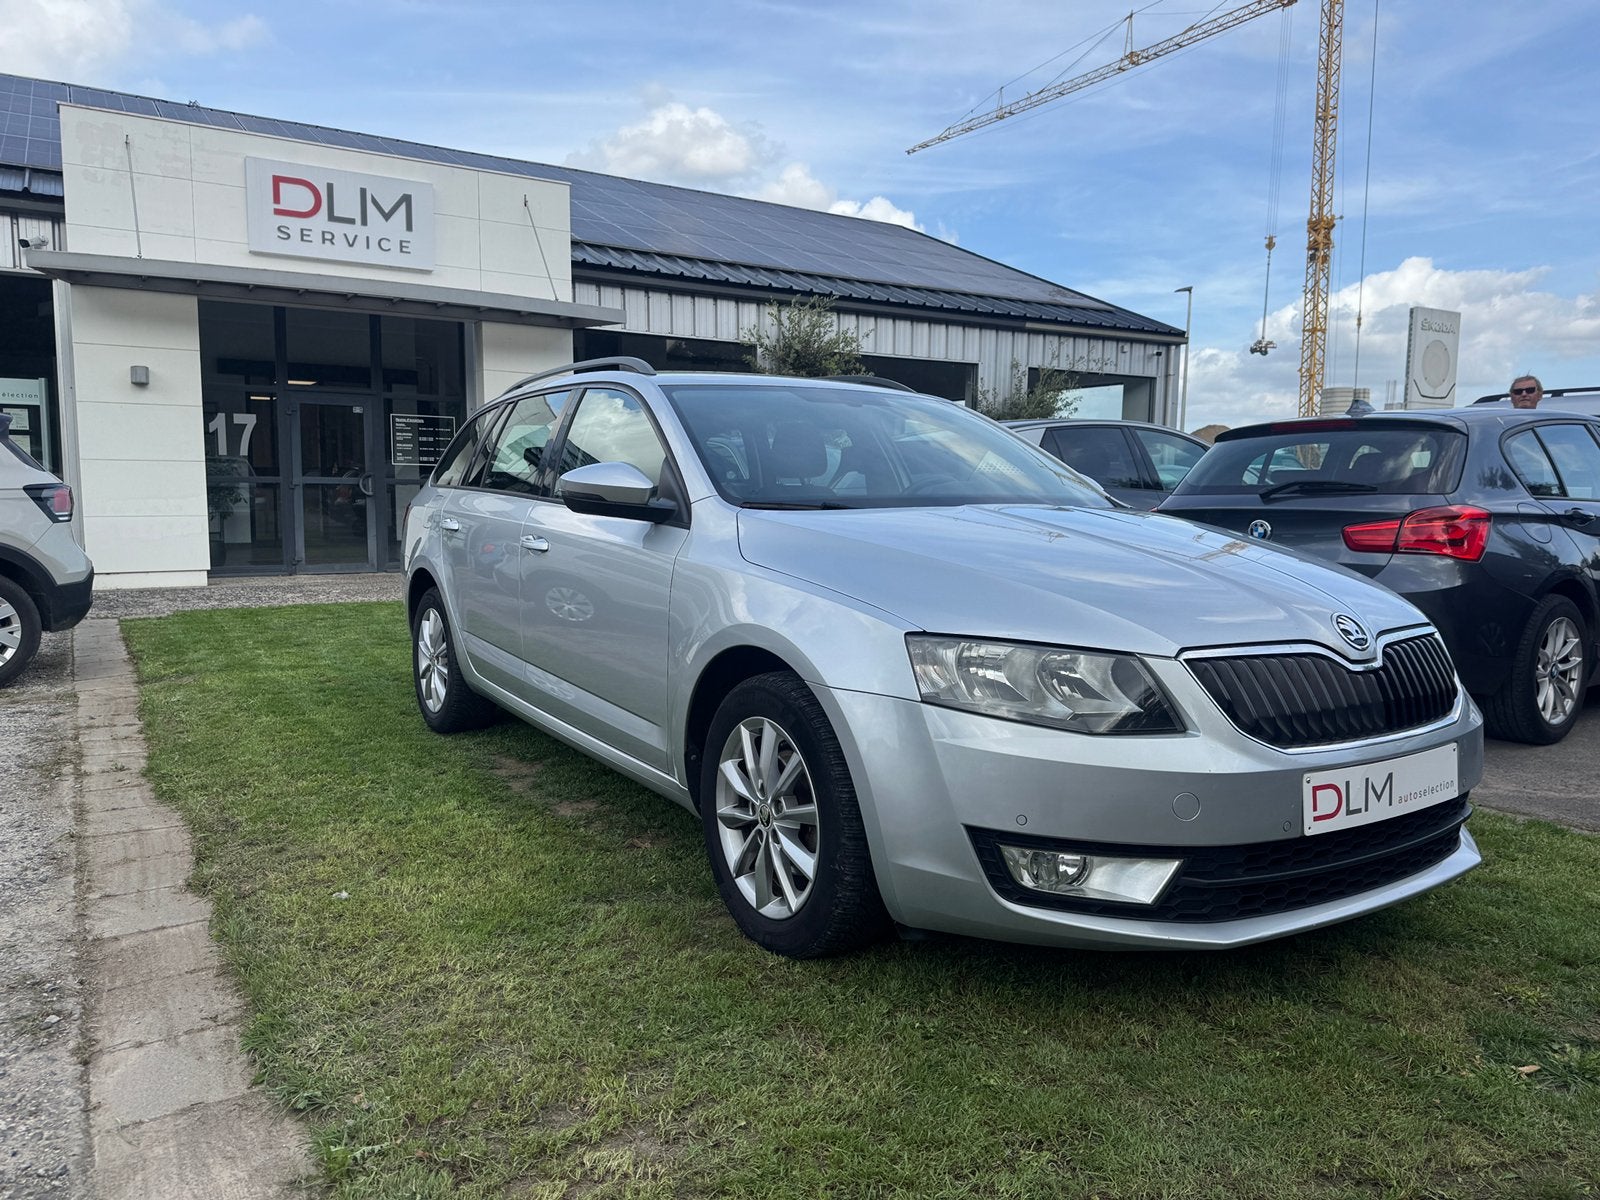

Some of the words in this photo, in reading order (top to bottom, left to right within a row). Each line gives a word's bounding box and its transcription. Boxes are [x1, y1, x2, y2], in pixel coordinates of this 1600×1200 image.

[272, 174, 413, 232] DLM
[276, 225, 411, 254] SERVICE
[208, 412, 257, 456] 17
[1312, 772, 1393, 822] DLM
[1397, 779, 1454, 804] autoselection
